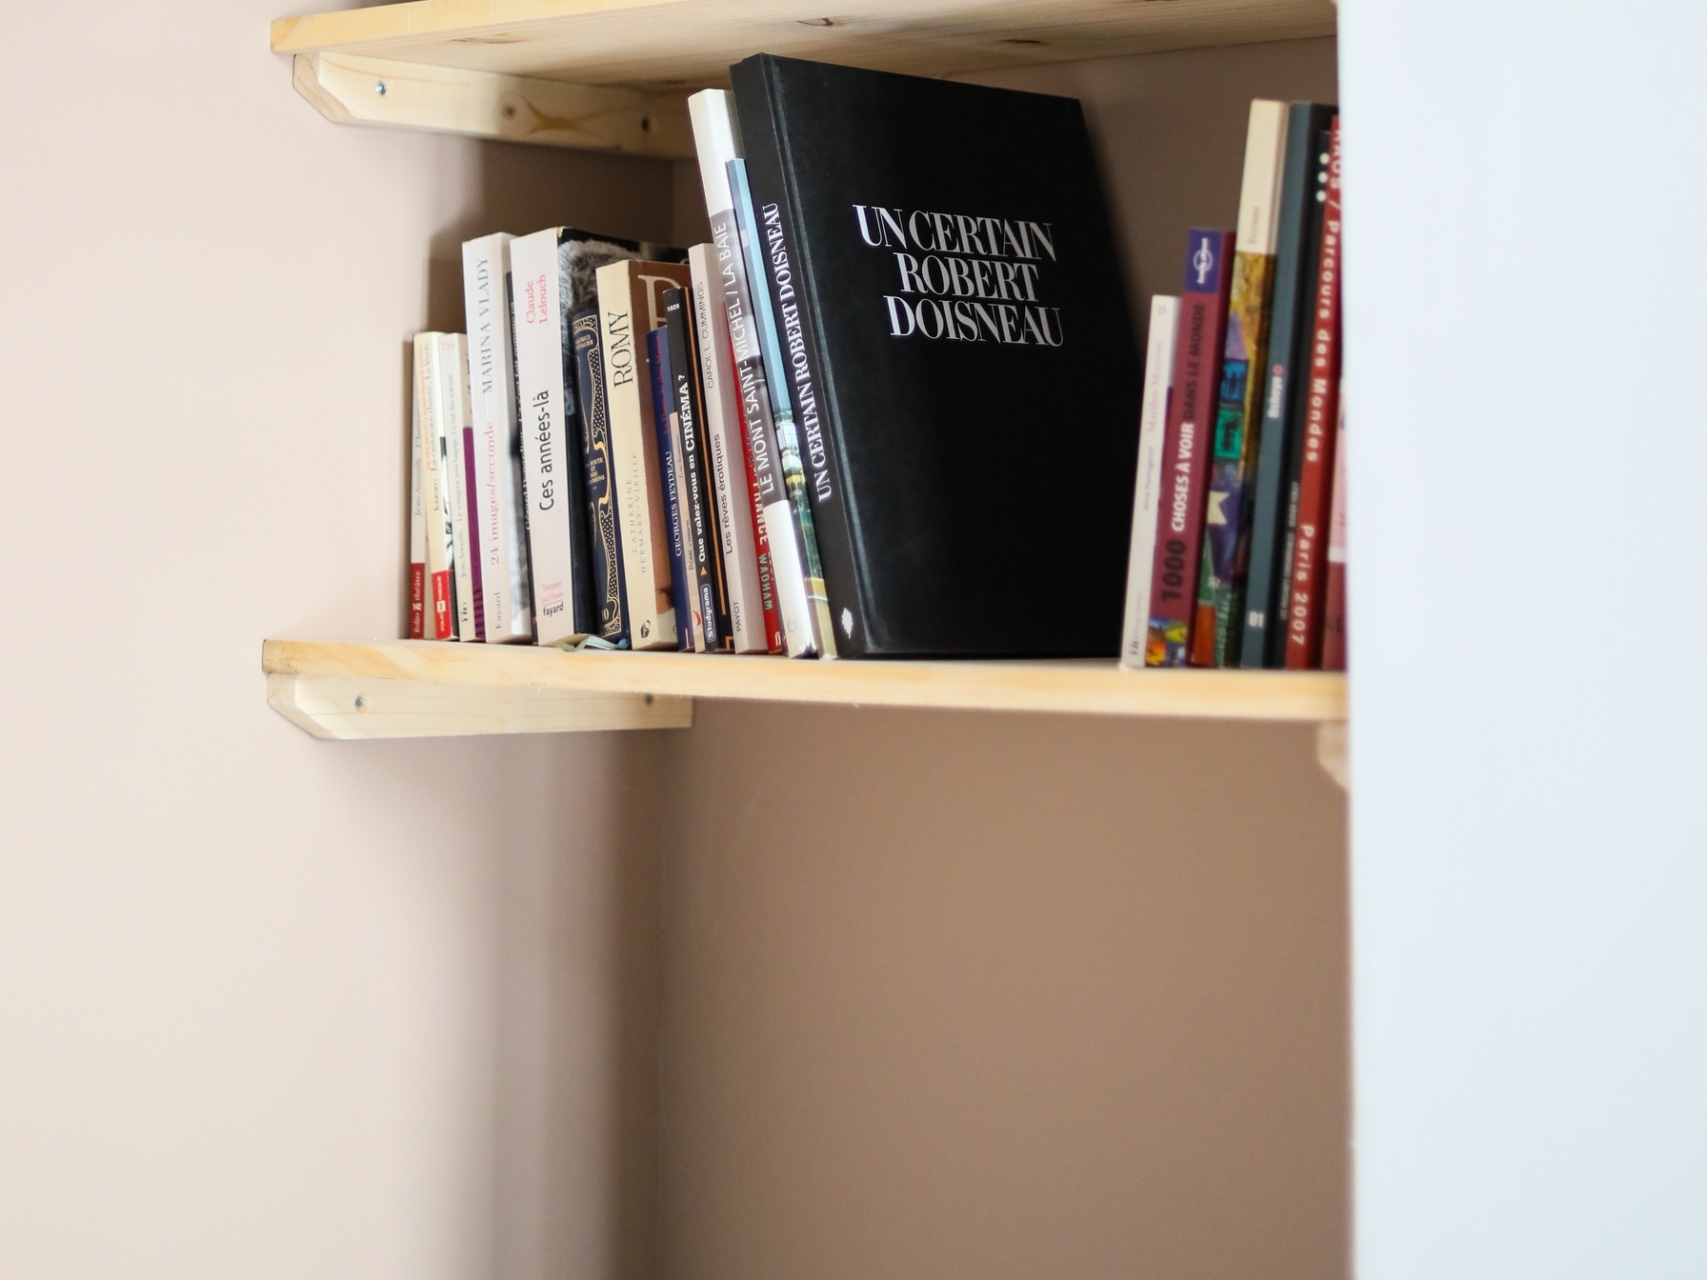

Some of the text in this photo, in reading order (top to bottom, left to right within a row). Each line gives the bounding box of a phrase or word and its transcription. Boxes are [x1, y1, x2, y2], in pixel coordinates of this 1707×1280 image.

[713, 223, 732, 258] BAIE
[852, 204, 1057, 262] UN CERTAIN
[721, 264, 737, 287] LA
[893, 251, 1040, 302] ROBERT
[1317, 219, 1340, 320] Parcours
[475, 258, 493, 394] MARINA VLADY
[525, 281, 537, 325] Claude
[536, 274, 549, 325] Lelouch
[696, 281, 710, 339] CUMMINGS
[883, 294, 1064, 347] DOISNEAU
[607, 310, 634, 390] ROMY
[727, 299, 760, 415] SAINT-MICHEL
[762, 203, 832, 502] UN CERTAIN ROBERT DOISNEAU
[1189, 304, 1207, 357] MONDE
[1312, 327, 1332, 369] des
[677, 373, 686, 382] ?
[704, 352, 715, 389] CAROL
[1186, 360, 1201, 377] LE
[678, 382, 696, 451] CINÉMA
[1182, 380, 1198, 421] DANS
[1305, 376, 1329, 463] Mondes
[531, 389, 555, 510] Ces années-là
[687, 454, 695, 468] en
[748, 419, 771, 472] MONT
[1176, 421, 1195, 459] VOIR
[484, 420, 500, 565] 24 images/seconde
[664, 450, 682, 557] GEORGES FEYDEAU
[689, 472, 703, 535] valez-vous
[711, 433, 734, 554] Les rêves érotiques
[759, 473, 775, 495] LE
[1169, 473, 1190, 531] CHOSES
[625, 477, 638, 553] CATHERINE
[697, 537, 707, 562] Que
[1160, 536, 1187, 602] 1000
[758, 552, 773, 610] WADHAM
[1290, 523, 1316, 647] Paris 2007
[493, 591, 503, 630] Fayard
[543, 601, 564, 617] fayard
[702, 586, 714, 638] Studyrama
[733, 601, 742, 632] PAYOT
